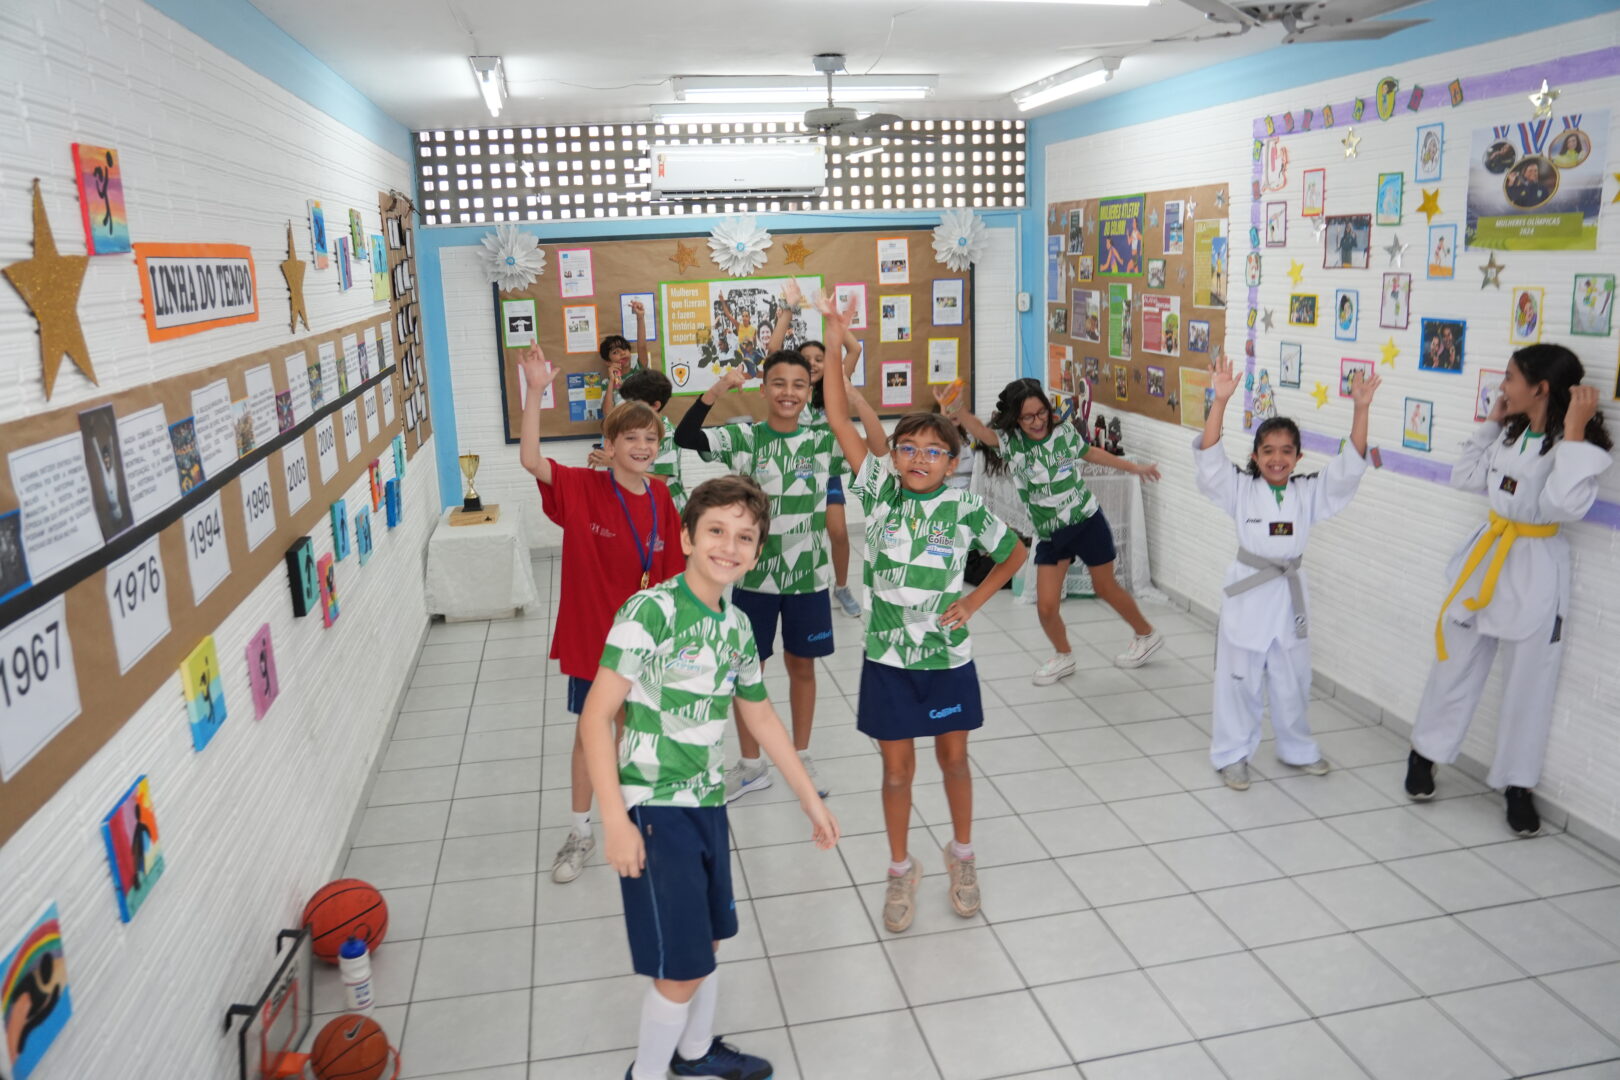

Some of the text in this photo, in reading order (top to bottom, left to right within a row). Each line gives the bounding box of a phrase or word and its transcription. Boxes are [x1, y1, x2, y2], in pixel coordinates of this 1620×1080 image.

[150, 264, 252, 316] LINHA DO TEMPO
[671, 287, 699, 297] Mulheres
[671, 299, 707, 310] que fizeram
[672, 321, 696, 331] história
[677, 310, 696, 320] fazem
[344, 409, 357, 437] 2016
[318, 425, 334, 457] 2008
[287, 456, 307, 492] 2003
[246, 481, 271, 523] 1996
[189, 508, 222, 559] 1994
[113, 555, 161, 619] 1976
[0, 620, 60, 708] 1967
